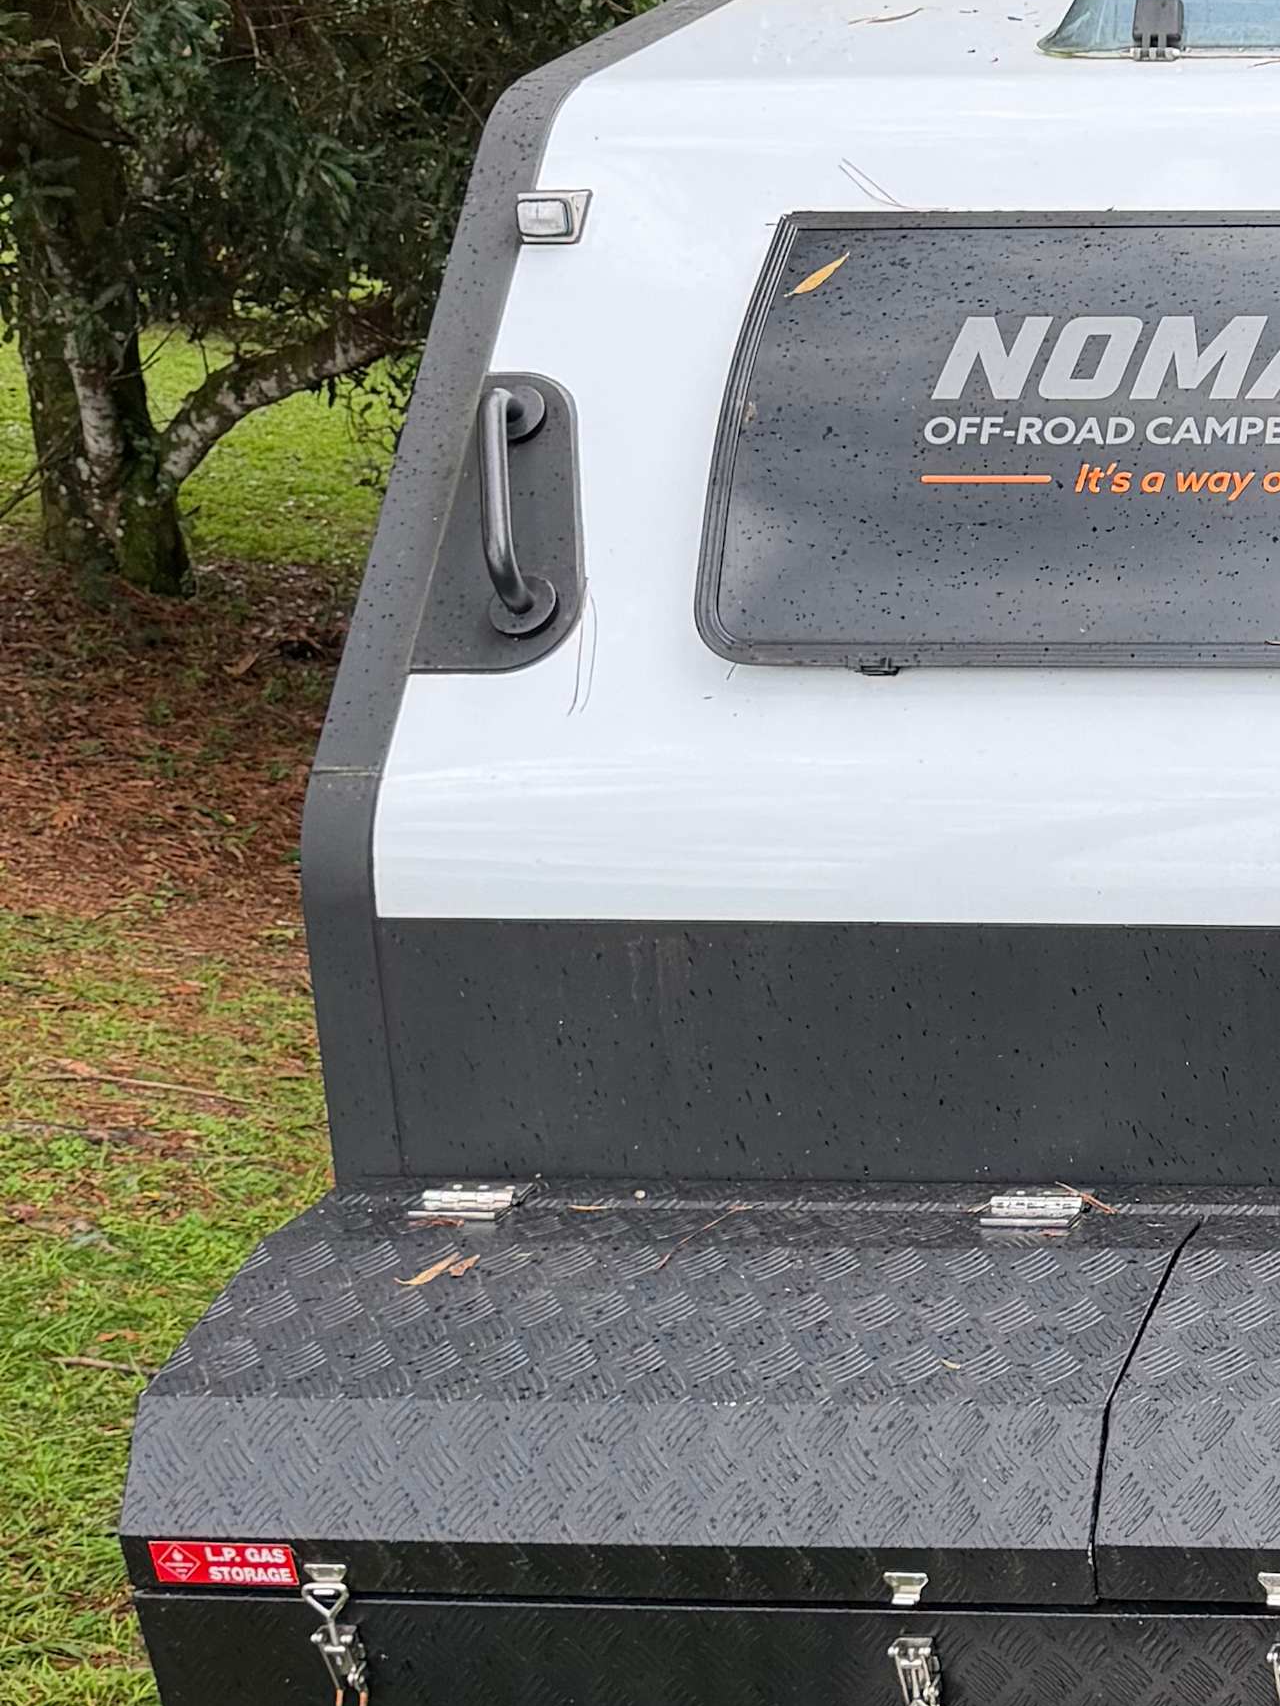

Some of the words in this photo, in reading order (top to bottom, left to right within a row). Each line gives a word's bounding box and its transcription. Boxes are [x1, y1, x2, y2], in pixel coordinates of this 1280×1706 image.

[923, 415, 1136, 446] OFF-ROAD
[1076, 463, 1131, 493] It's
[1141, 471, 1164, 492] a
[1175, 471, 1256, 500] way
[204, 1546, 242, 1562] L.P.
[244, 1547, 287, 1564] GAS
[208, 1565, 293, 1583] STORAGE
